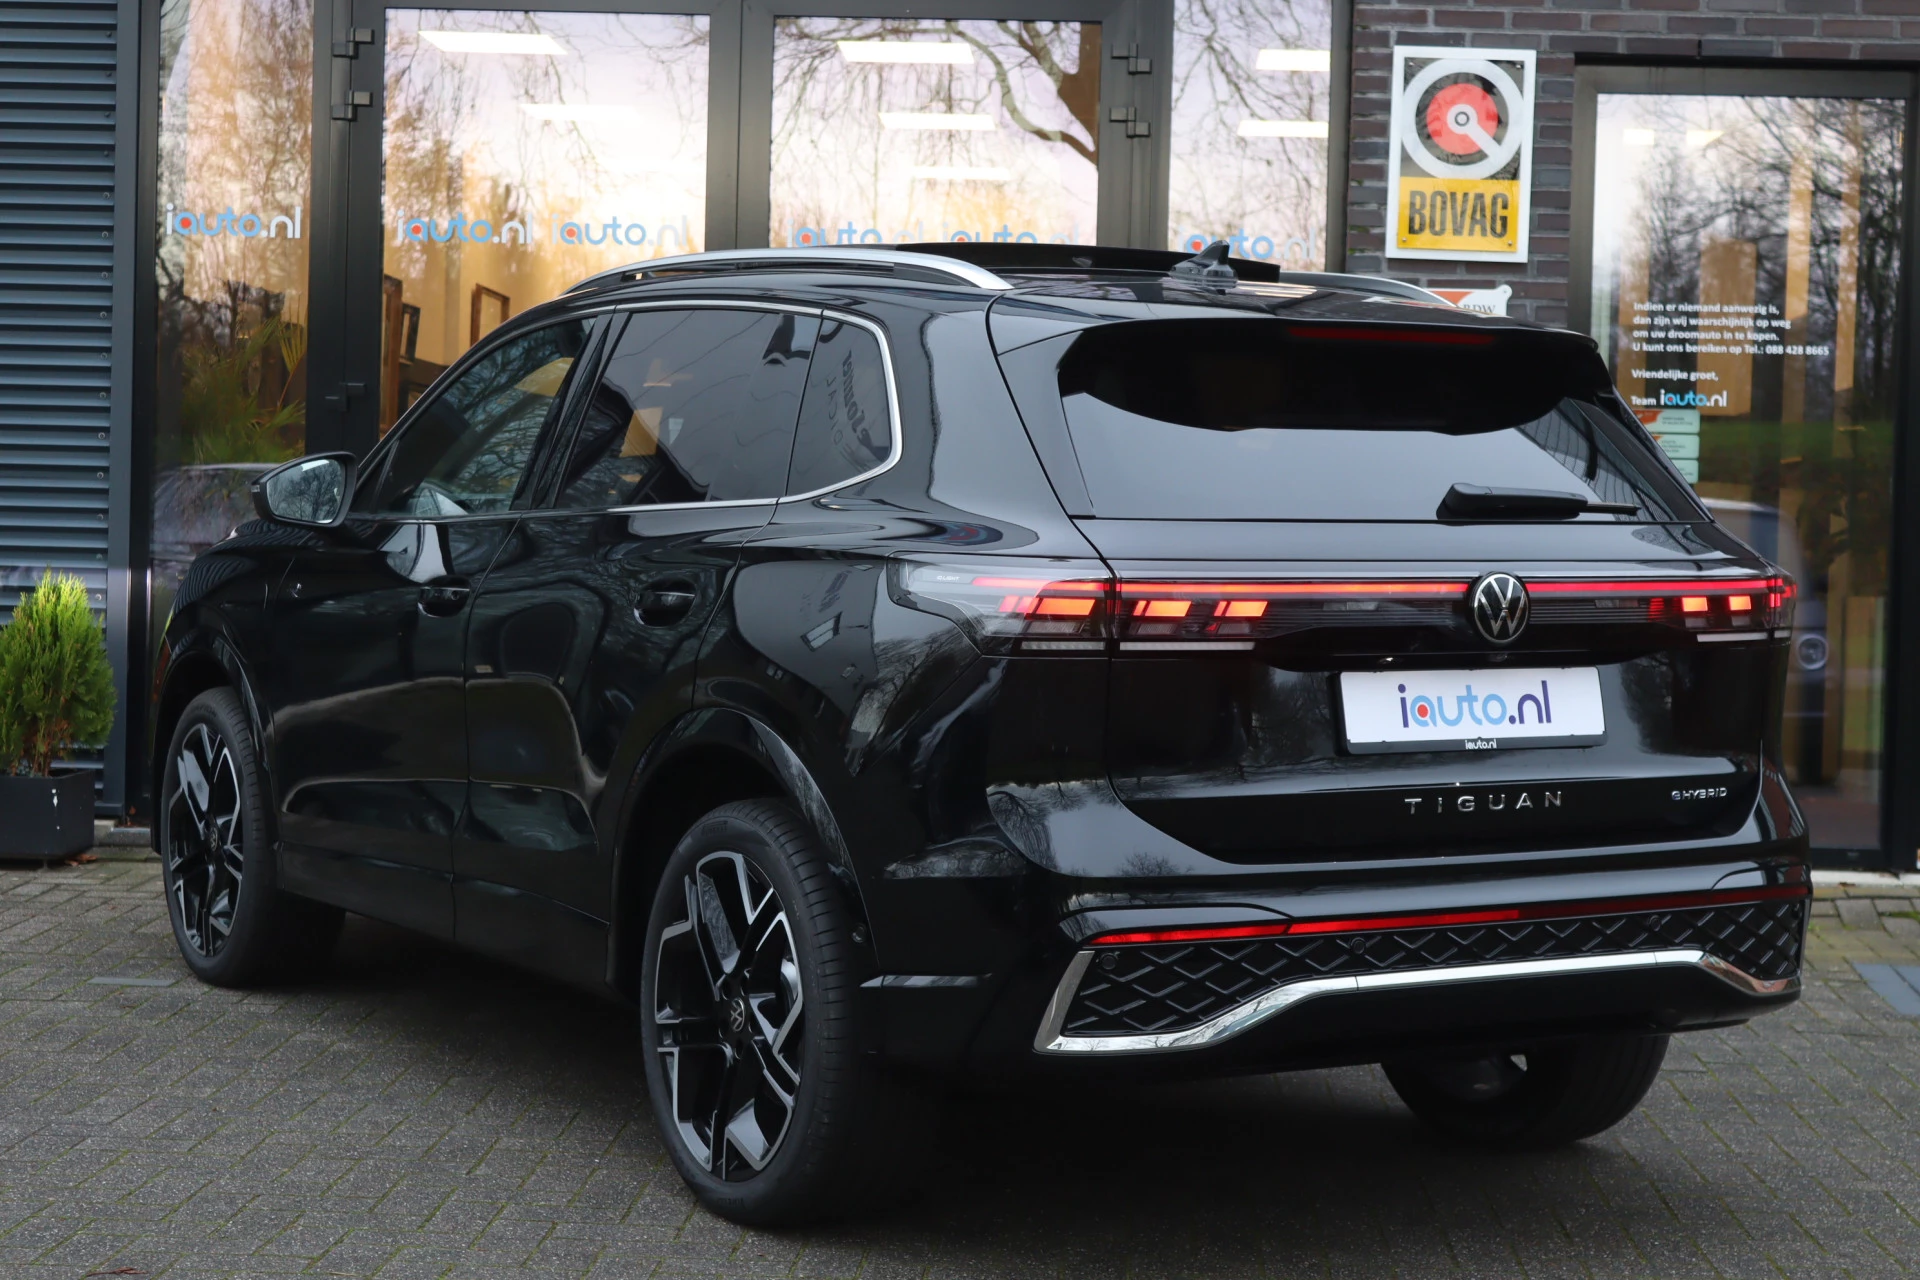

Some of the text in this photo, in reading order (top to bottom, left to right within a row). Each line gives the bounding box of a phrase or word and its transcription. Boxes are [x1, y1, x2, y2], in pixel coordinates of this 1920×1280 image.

[166, 203, 302, 238] iauto.nl
[1408, 190, 1509, 238] BOVAG
[396, 209, 533, 244] iauto.nl
[552, 213, 688, 246] iauto.nl
[1634, 302, 1780, 315] Indien er niemand aanwezig is,
[1633, 315, 1791, 329] dan zijn wij waarschijnlijk op weg
[1633, 329, 1780, 342] om uw droomauto in te kopen.
[1633, 342, 1640, 351] U
[1643, 342, 1664, 352] kunt
[1666, 344, 1683, 353] ons
[1685, 343, 1727, 354] bereiken
[1729, 346, 1742, 356] op
[1766, 345, 1784, 355] 088
[1785, 345, 1804, 355] 428
[1805, 346, 1829, 356] 8665
[1631, 369, 1719, 382] Vriendelijke groet,
[1631, 388, 1727, 407] Team iauto.nl
[1398, 680, 1552, 728] iauto.nl
[1465, 739, 1497, 750] iauto.nl
[1405, 791, 1562, 815] TIGUAN
